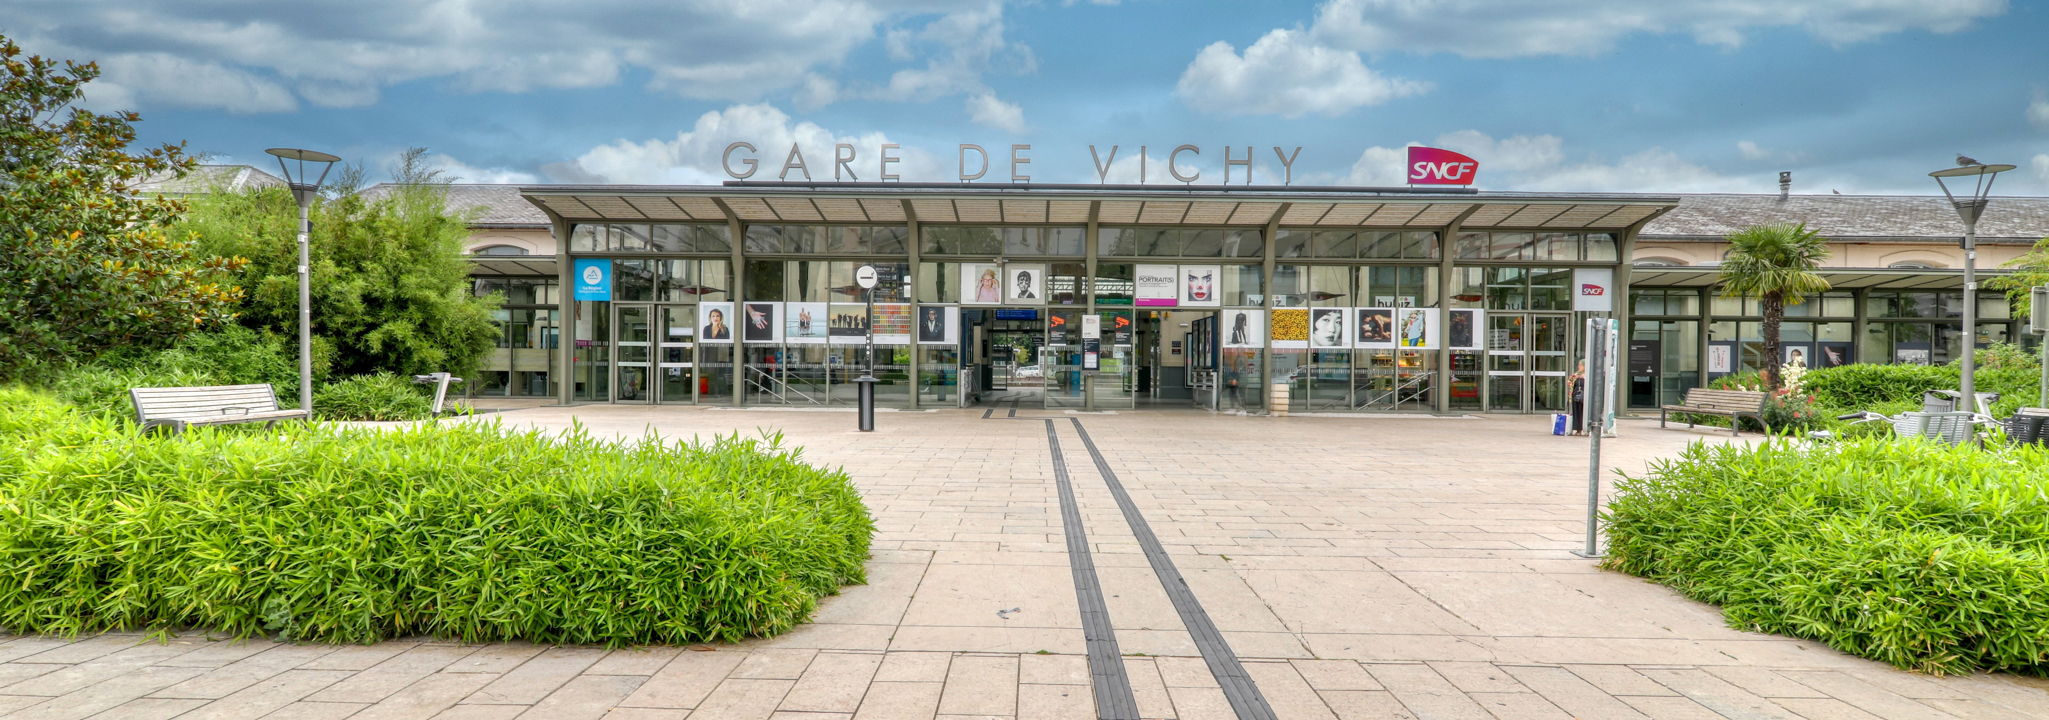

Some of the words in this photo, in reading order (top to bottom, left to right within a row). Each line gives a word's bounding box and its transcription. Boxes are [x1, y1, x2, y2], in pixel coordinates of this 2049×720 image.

[722, 141, 900, 180] GARE
[959, 143, 1031, 181] DE
[1088, 143, 1303, 184] VICHY
[1410, 161, 1475, 180] SNCF
[1138, 276, 1175, 284] PORTRAIT(S)
[1582, 287, 1603, 295] SNCF
